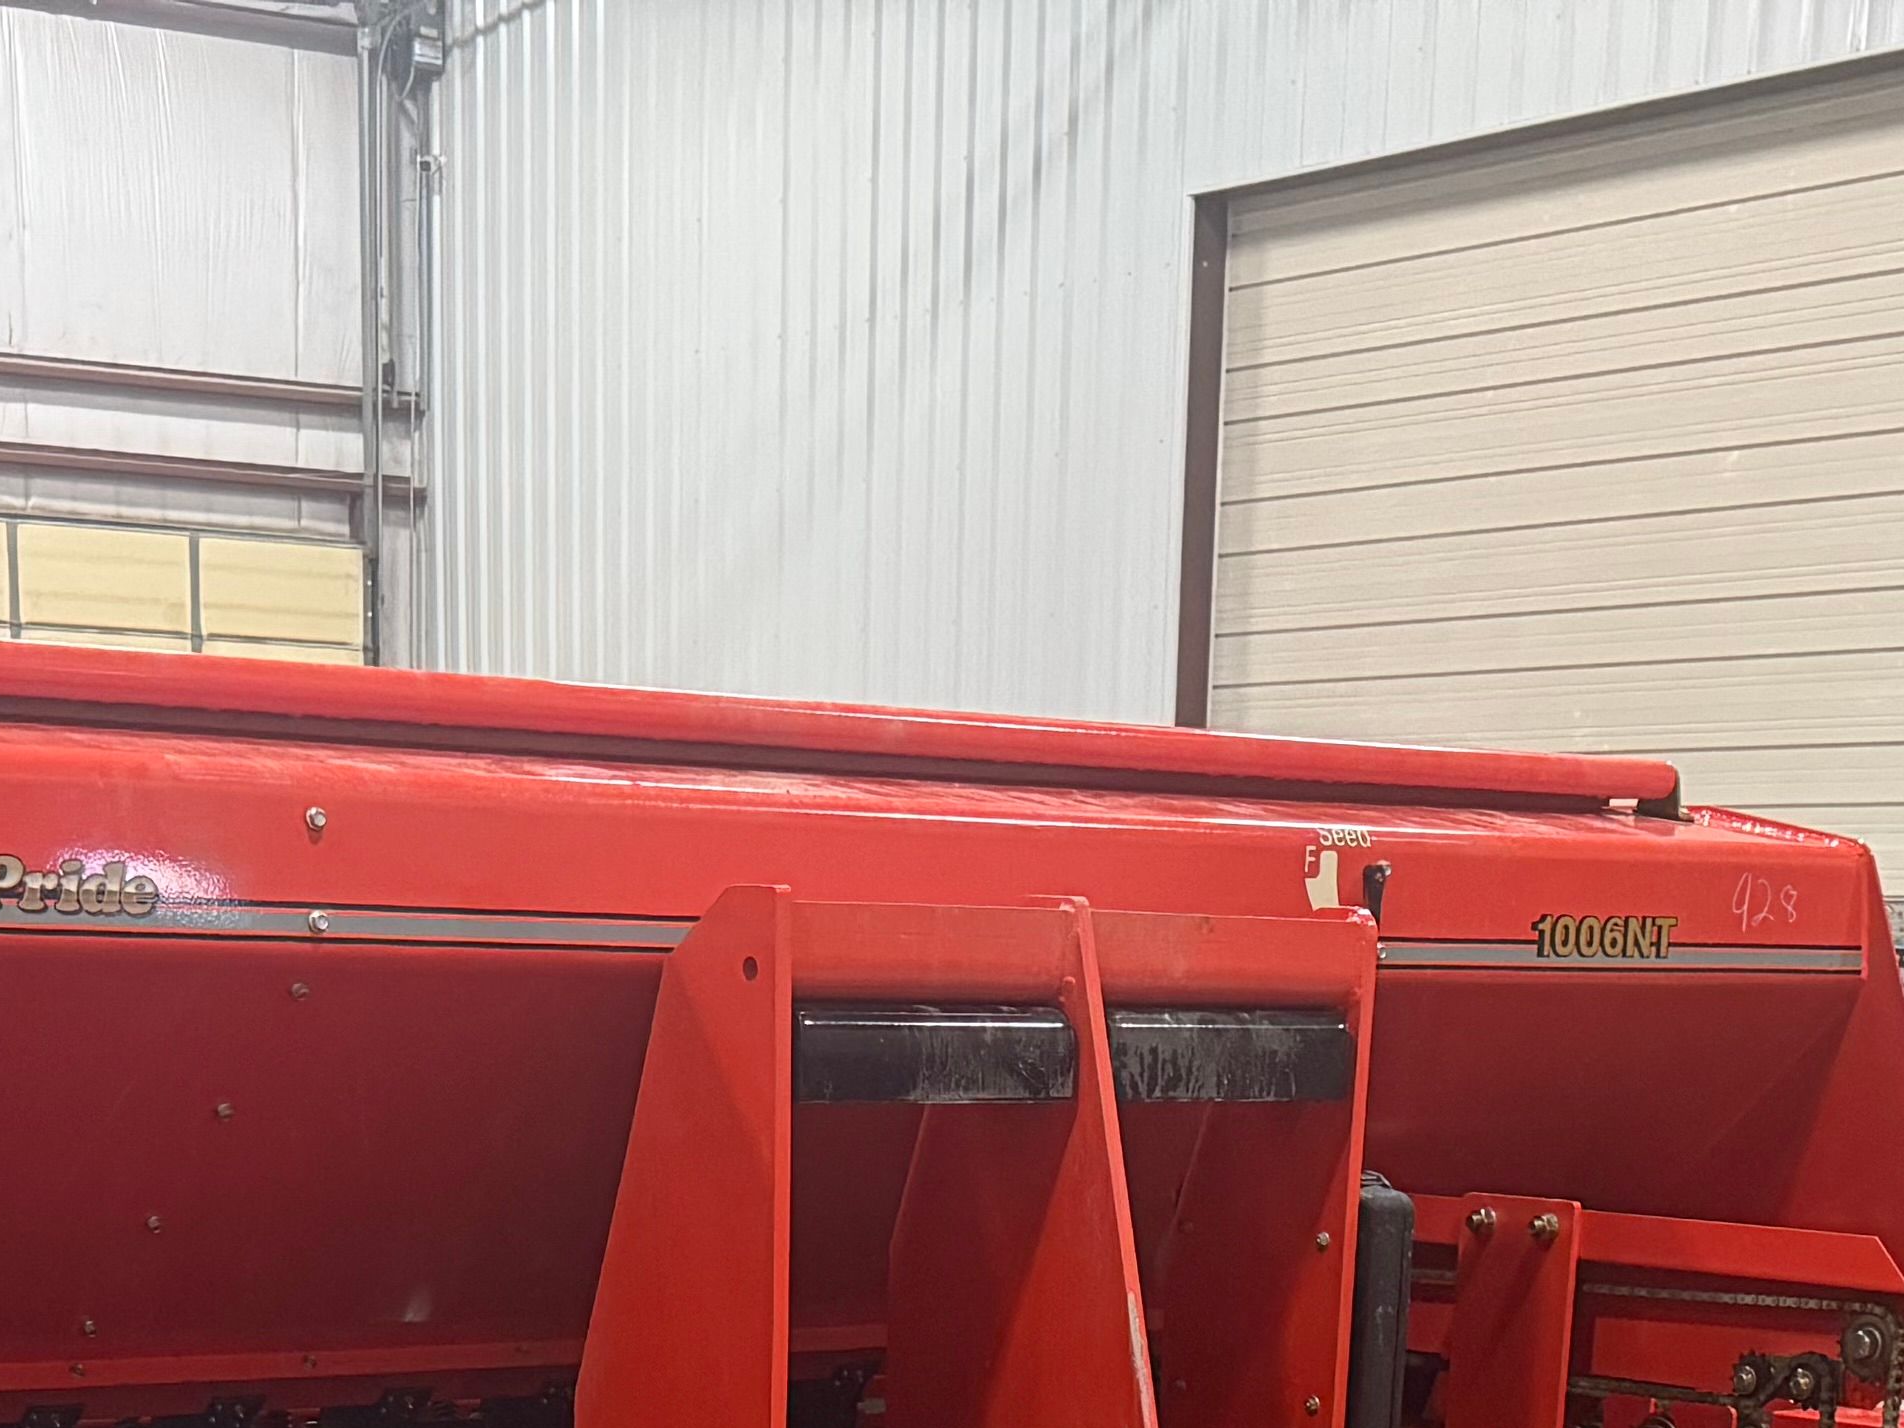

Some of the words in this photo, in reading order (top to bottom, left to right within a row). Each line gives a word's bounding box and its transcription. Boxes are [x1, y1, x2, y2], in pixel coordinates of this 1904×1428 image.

[1304, 845, 1317, 873] F
[1732, 872, 1798, 932] 928
[1531, 914, 1678, 959] 1006NT
